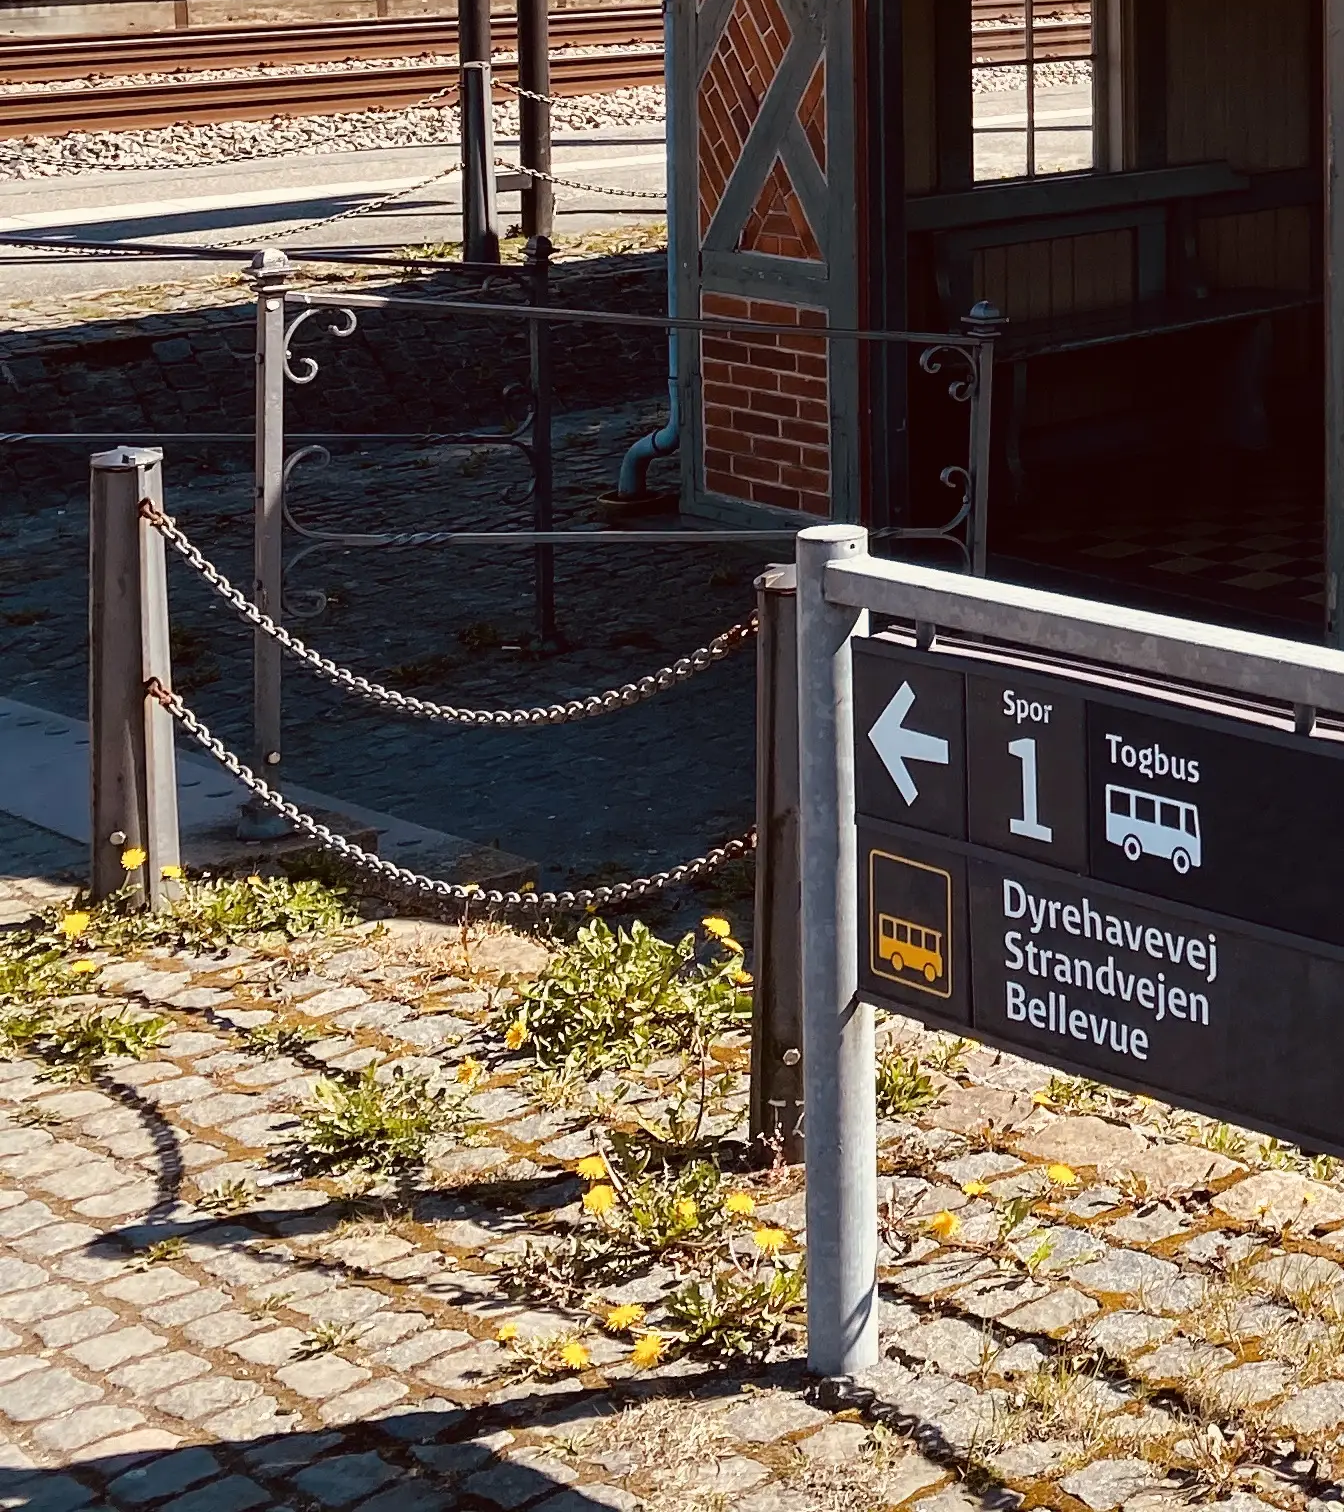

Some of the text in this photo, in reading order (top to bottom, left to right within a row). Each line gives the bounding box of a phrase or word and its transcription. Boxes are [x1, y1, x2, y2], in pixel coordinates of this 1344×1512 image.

[1003, 689, 1053, 724] Spor
[1008, 738, 1052, 843] 1
[1105, 733, 1200, 783] Togbus
[1003, 878, 1218, 983] Dyrehavevej
[1004, 930, 1209, 1026] Strandvejen
[1006, 980, 1149, 1060] Bellevue
